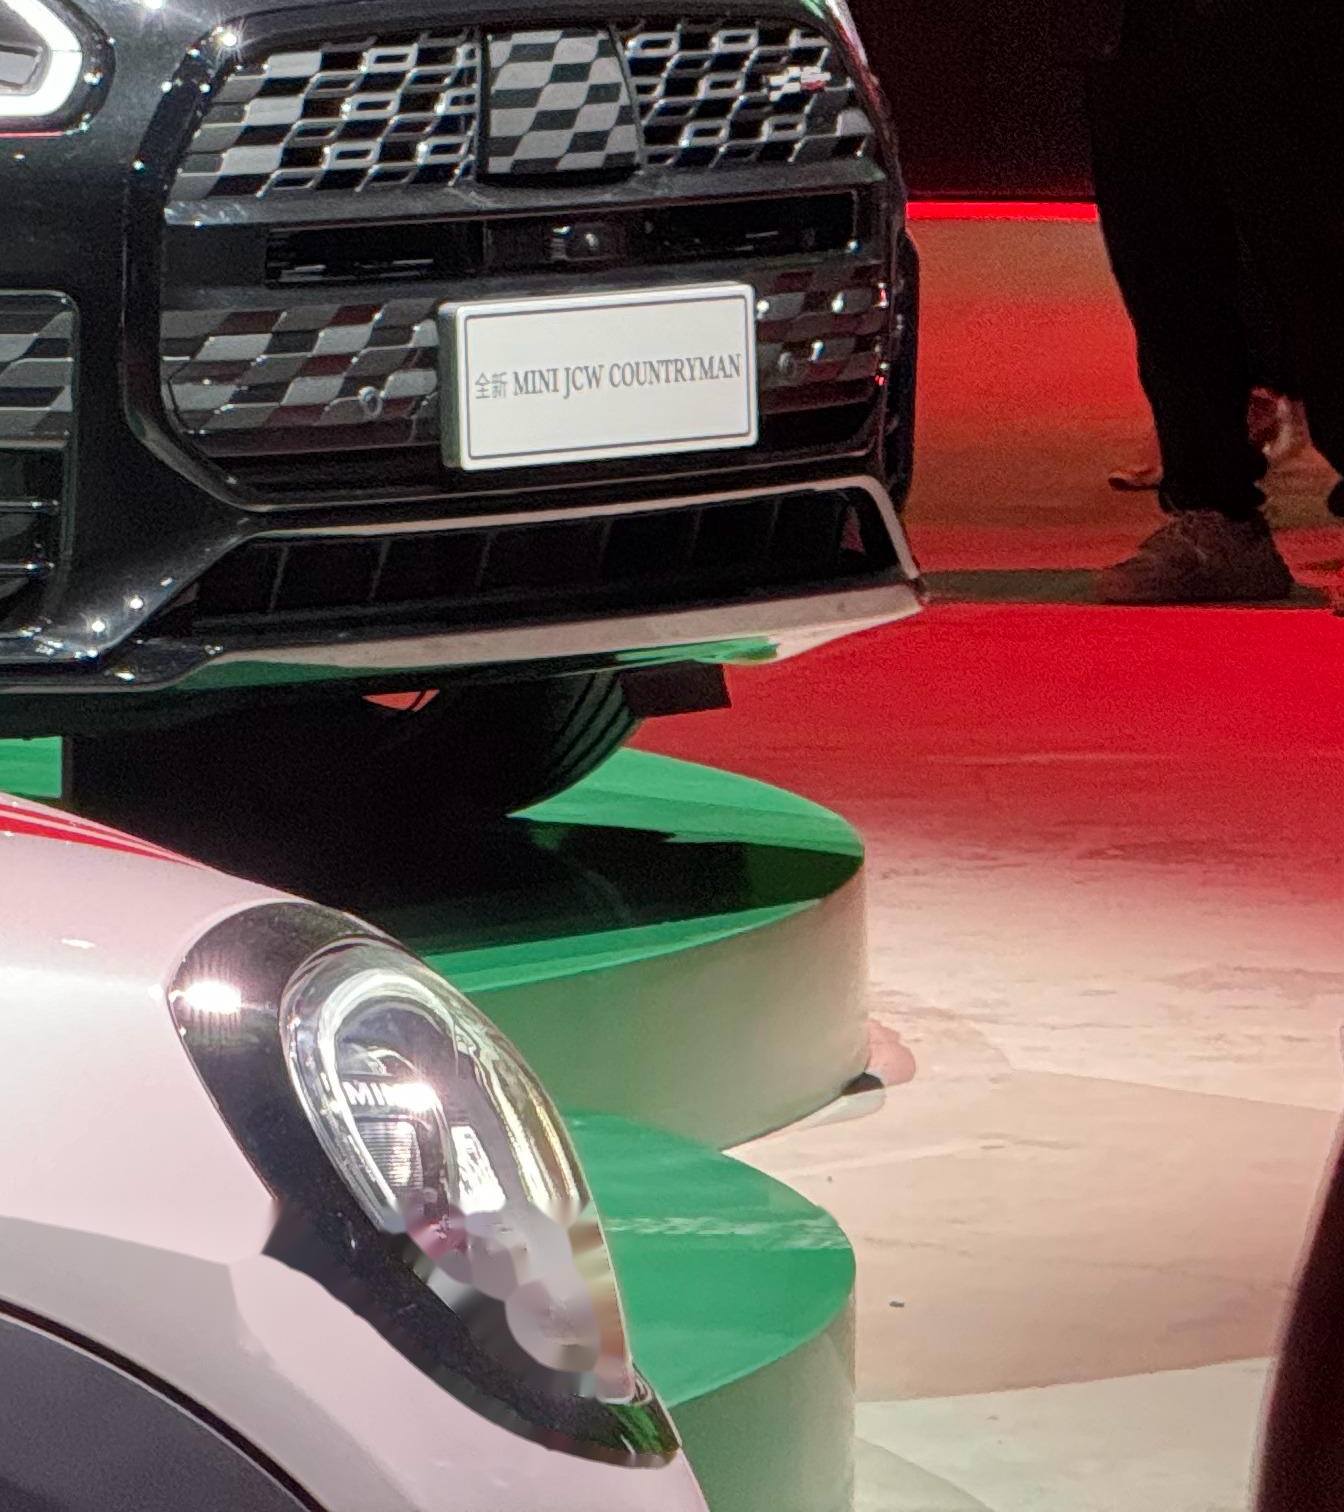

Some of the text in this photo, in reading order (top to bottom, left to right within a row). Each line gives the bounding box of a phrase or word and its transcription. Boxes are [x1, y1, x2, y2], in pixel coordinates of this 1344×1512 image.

[474, 352, 742, 400] 全新 MINI JCW COUNTRYMAN
[342, 1081, 430, 1109] MI
